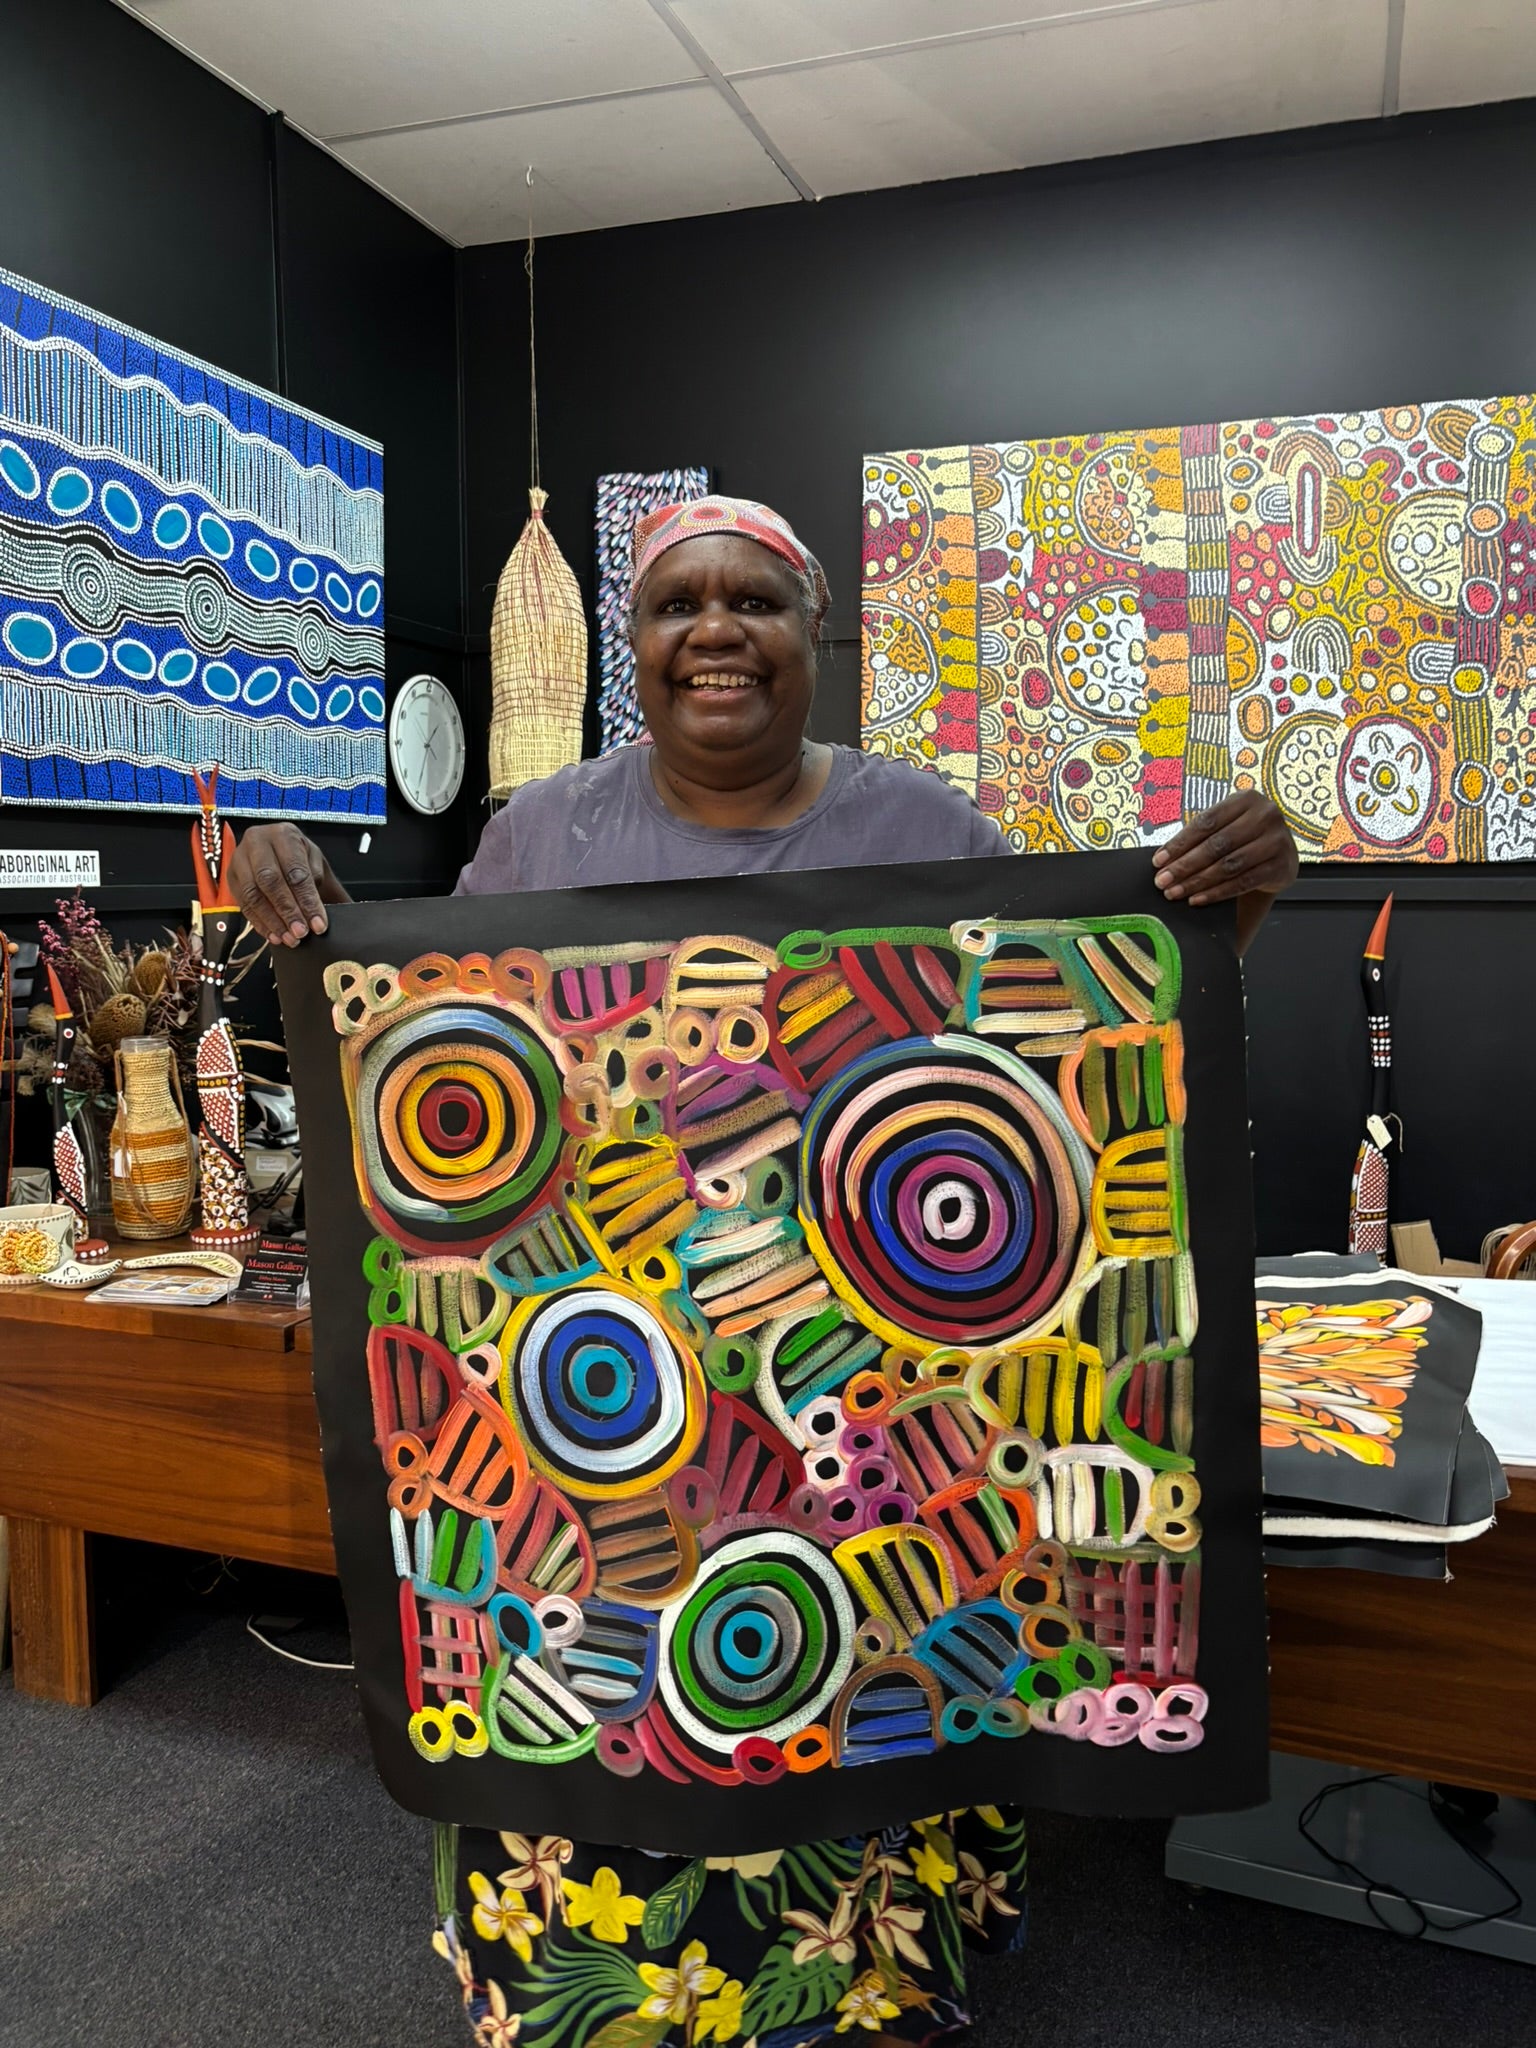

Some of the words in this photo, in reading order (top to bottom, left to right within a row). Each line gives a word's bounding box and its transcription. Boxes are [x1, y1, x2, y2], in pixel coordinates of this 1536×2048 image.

[0, 855, 71, 873] ABORIGINAL
[75, 855, 96, 873] ART
[48, 875, 57, 884] OF
[60, 874, 98, 884] AUSTRALIA
[246, 1258, 275, 1270] Mason
[275, 1261, 305, 1273] Gallery
